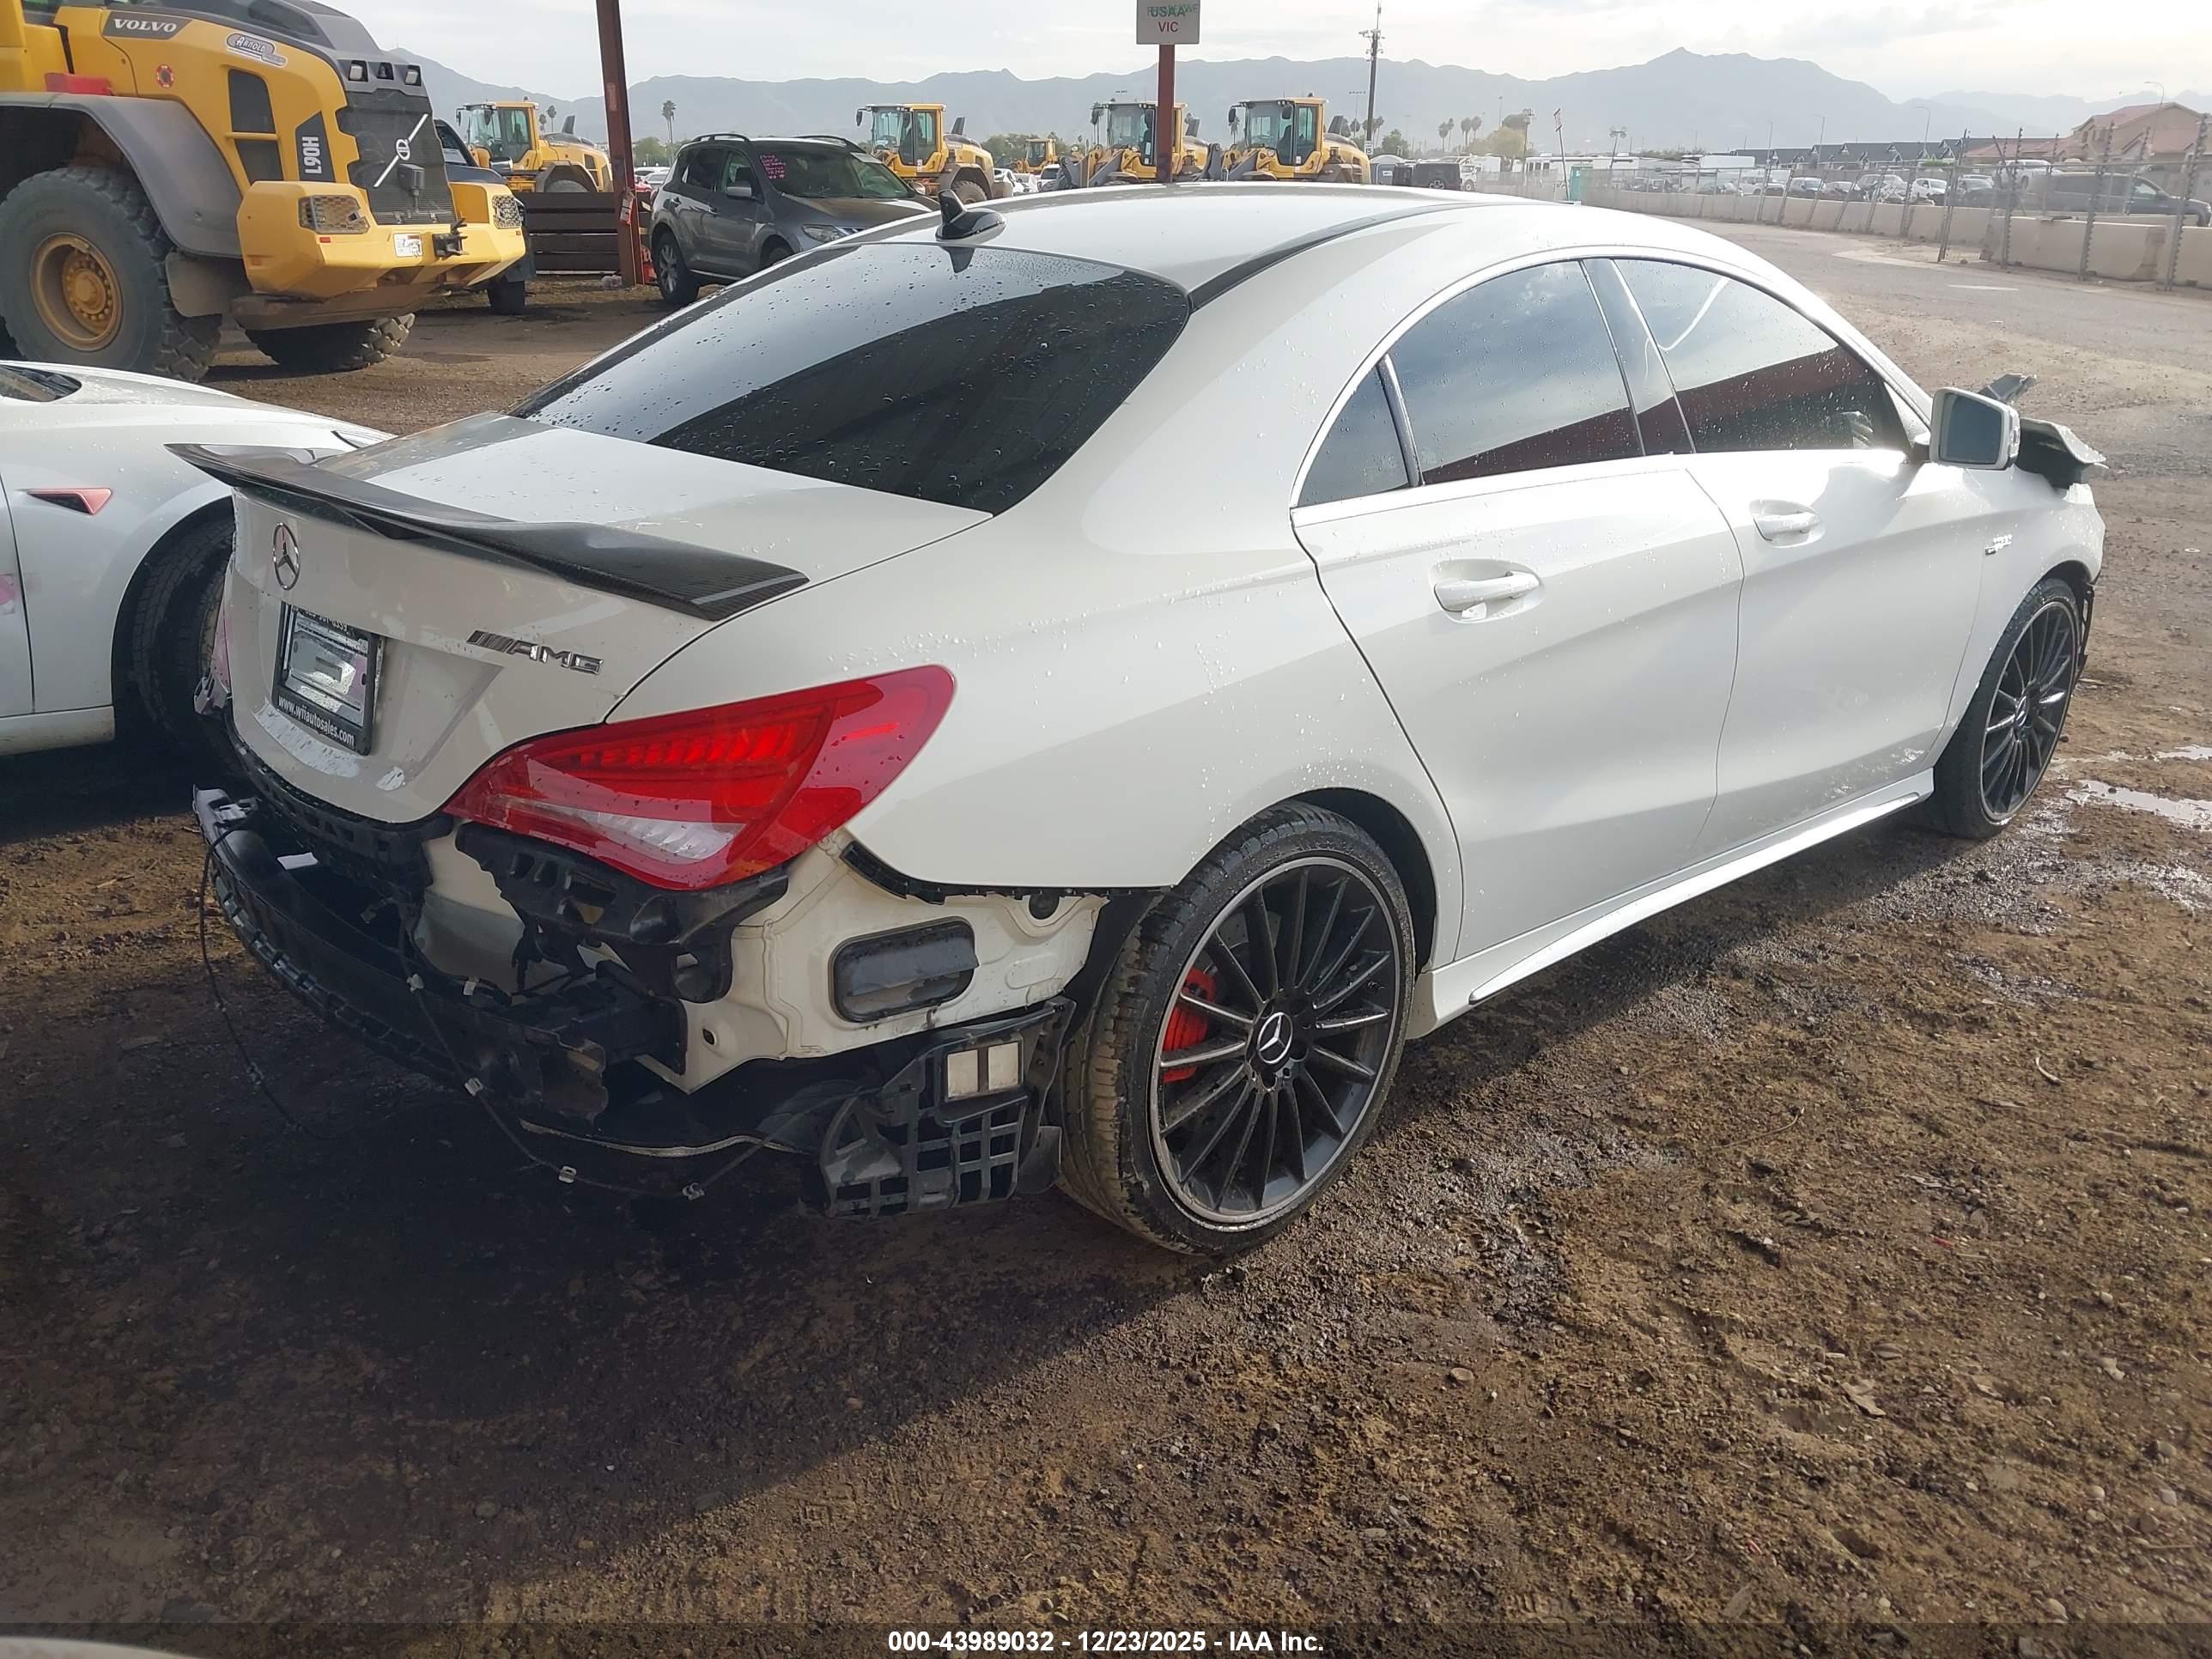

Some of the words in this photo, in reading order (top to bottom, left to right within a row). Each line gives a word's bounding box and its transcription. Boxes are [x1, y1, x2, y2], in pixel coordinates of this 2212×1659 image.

[113, 18, 177, 33] VOLVO
[1158, 21, 1179, 33] VIC
[301, 137, 323, 174] L90H
[278, 693, 355, 747] www.wiiautosales.com
